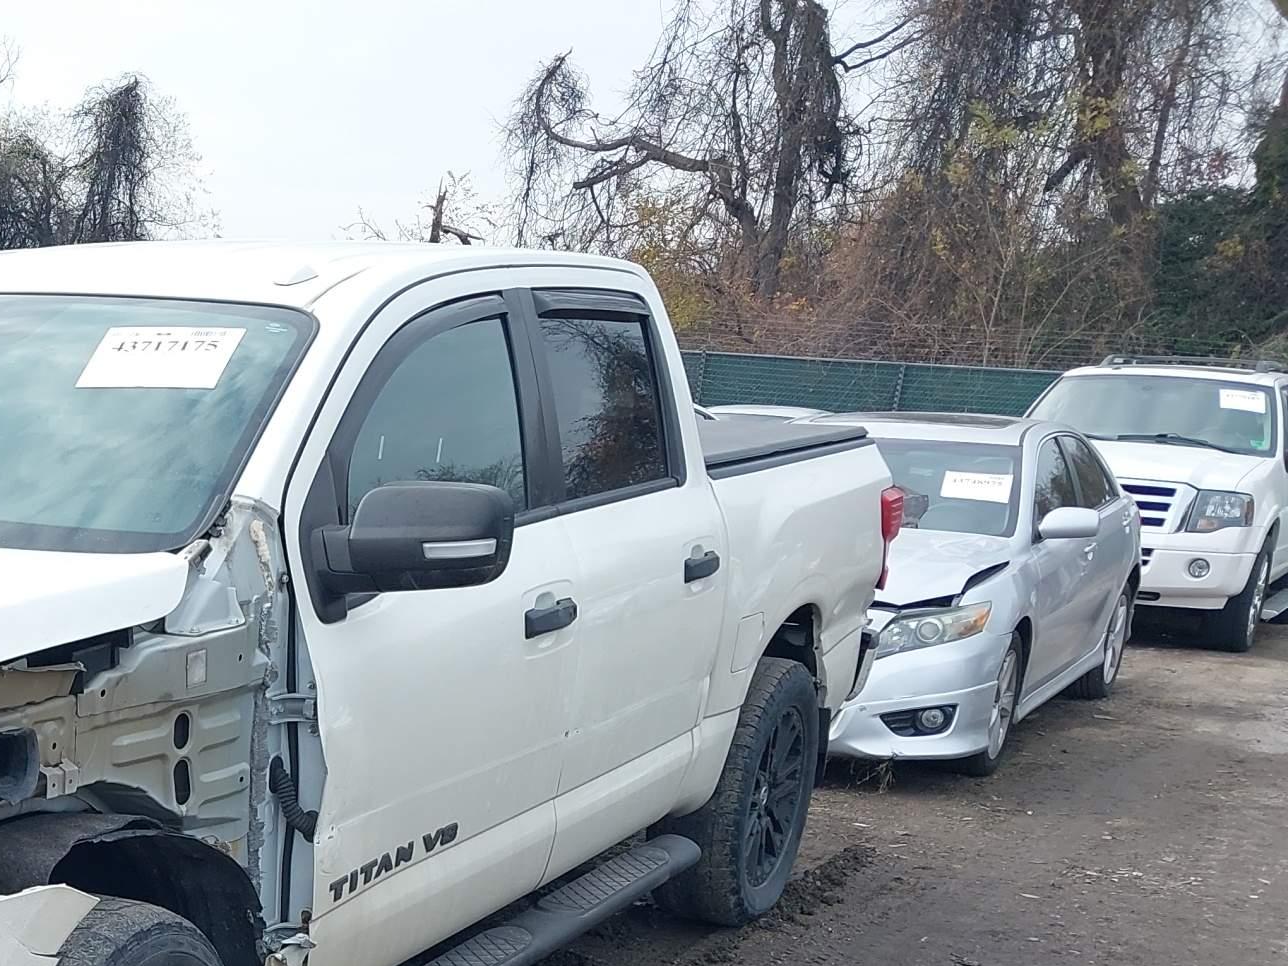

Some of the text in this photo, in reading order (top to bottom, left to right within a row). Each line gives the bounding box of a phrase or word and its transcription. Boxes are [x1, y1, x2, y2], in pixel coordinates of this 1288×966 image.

[112, 340, 220, 353] 43717175
[328, 821, 459, 902] TITAN V8
